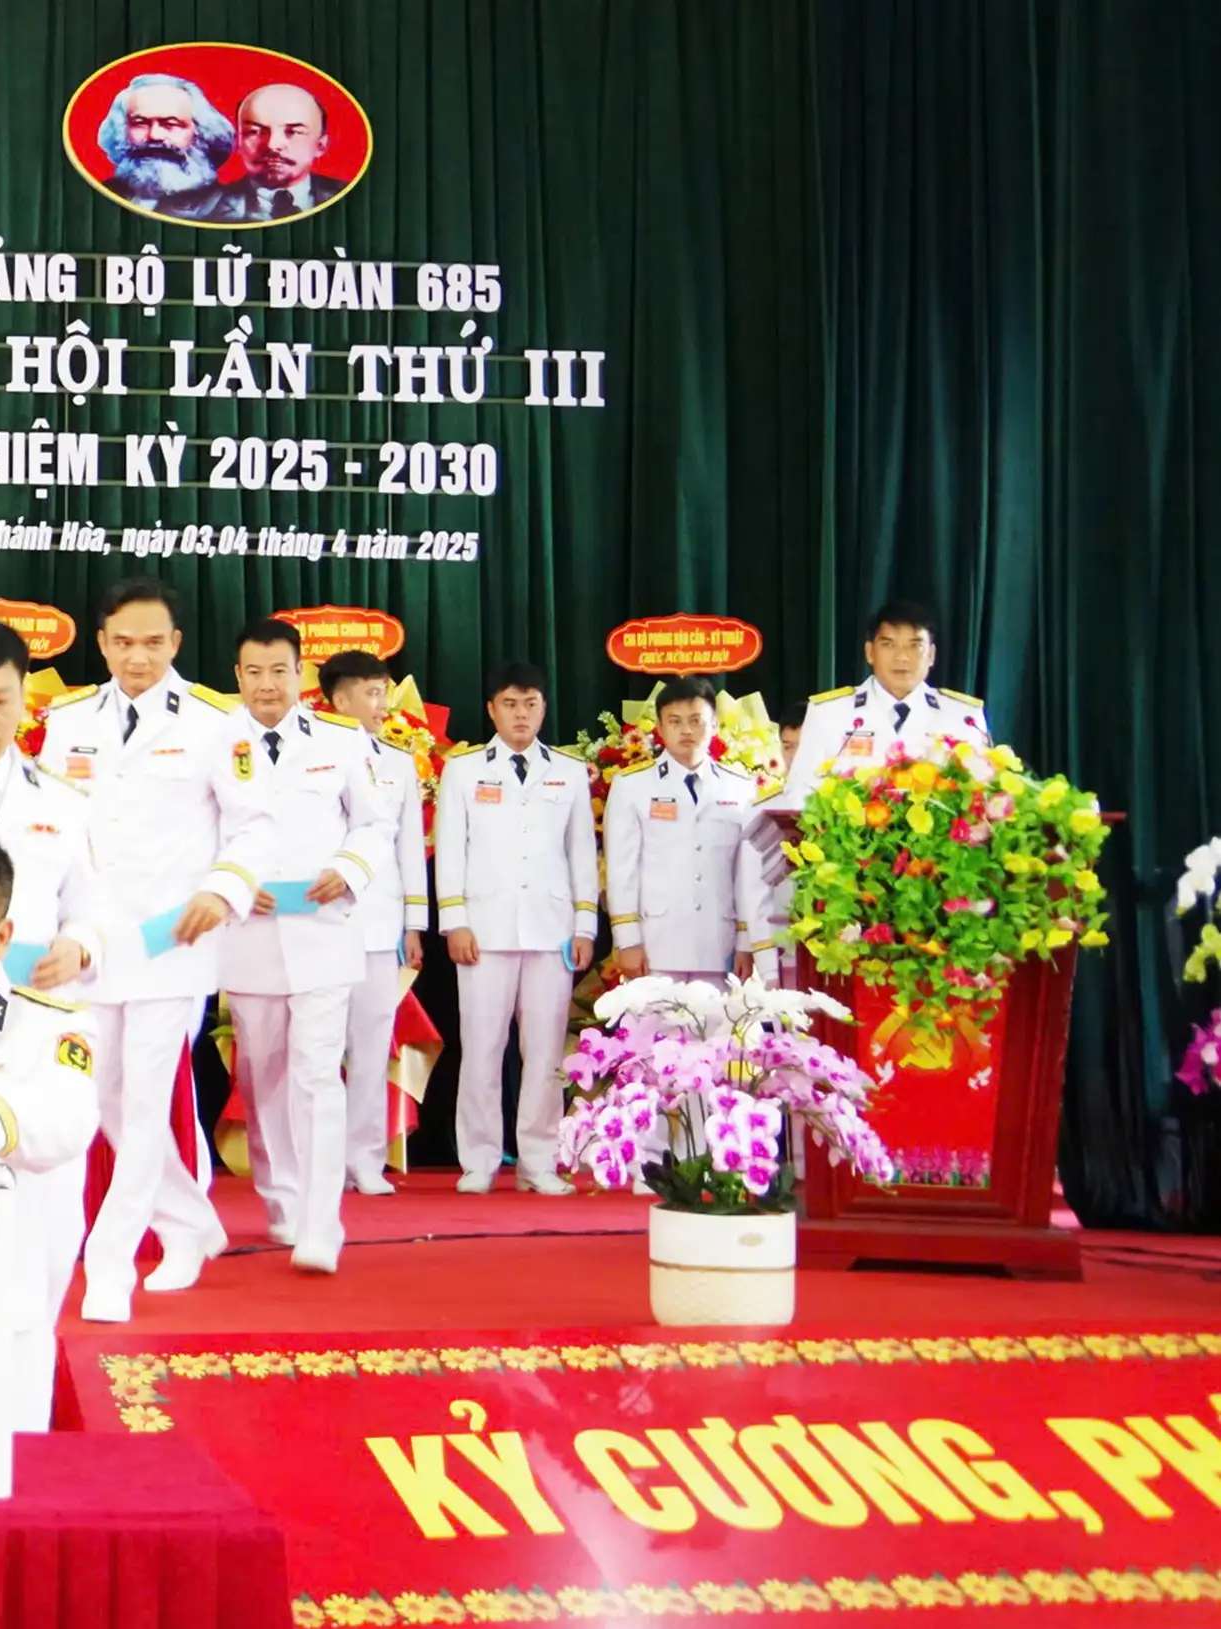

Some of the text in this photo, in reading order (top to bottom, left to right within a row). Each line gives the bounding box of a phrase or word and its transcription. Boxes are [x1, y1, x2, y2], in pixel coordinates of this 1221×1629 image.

[106, 244, 164, 315] BỘ
[194, 245, 252, 302] LỮ
[269, 248, 393, 310] ĐOÀN
[418, 264, 501, 312] 685
[6, 319, 127, 405] HỘI
[169, 316, 311, 399] LẦN
[348, 320, 492, 403] THỨ
[525, 350, 604, 407] III
[126, 422, 186, 487] KỲ
[210, 437, 327, 492] 2025
[345, 462, 361, 474] -
[379, 442, 496, 496] 2030
[59, 521, 110, 555] Hòa,
[121, 520, 178, 558] ngày
[257, 525, 325, 561] tháng
[331, 529, 347, 557] 4
[355, 528, 409, 559] năm
[416, 531, 479, 561] 2025
[365, 1400, 565, 1538] KỶ
[574, 1414, 1104, 1535] CƯƠNG,
